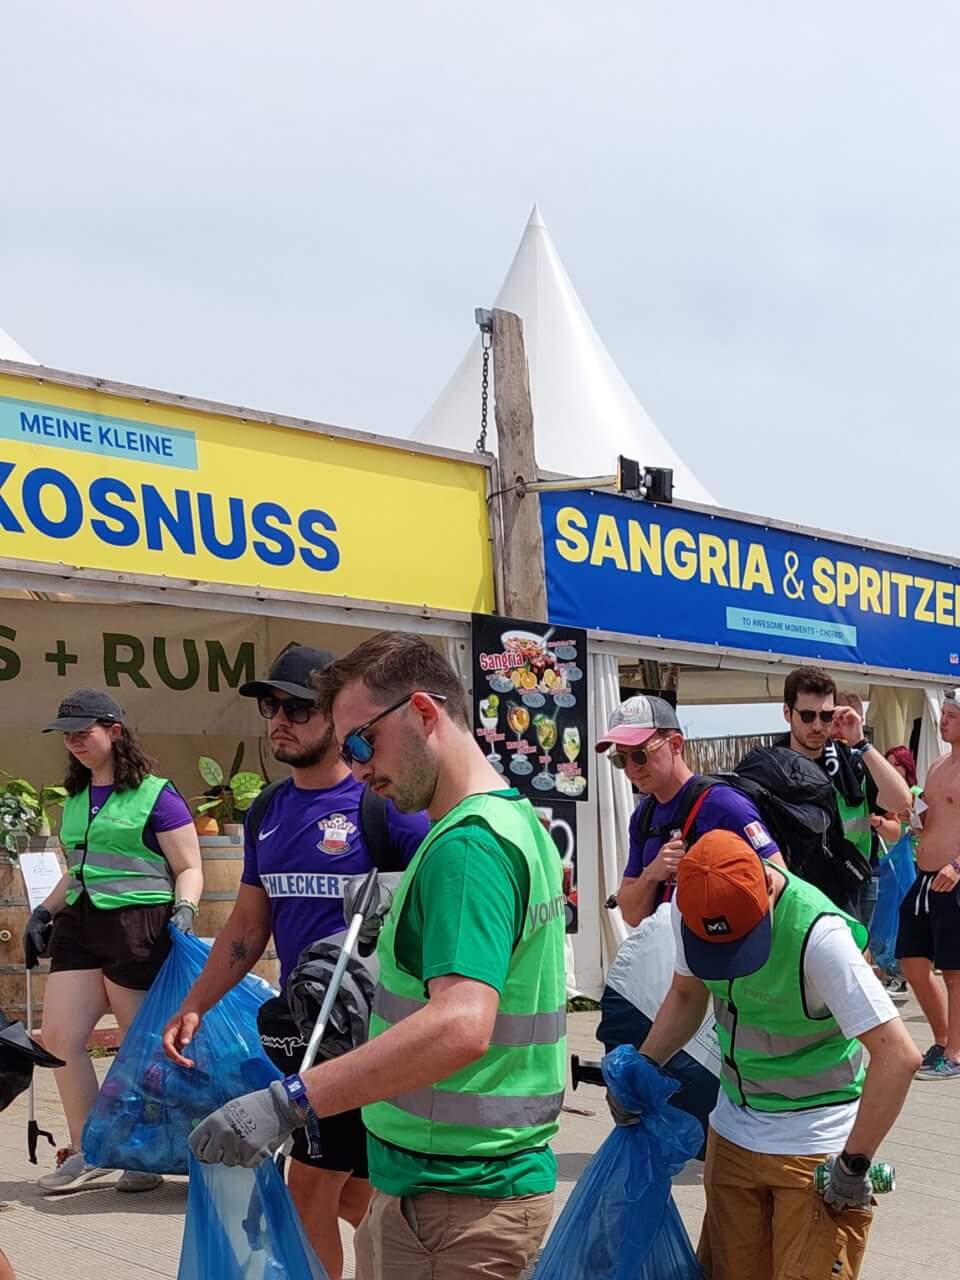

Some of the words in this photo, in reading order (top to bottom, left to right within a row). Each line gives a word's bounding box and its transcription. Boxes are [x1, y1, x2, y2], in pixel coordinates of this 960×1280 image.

[20, 411, 92, 443] MEINE
[99, 426, 173, 457] KLEINE
[555, 506, 775, 595] SANGRIA
[783, 551, 805, 601] &
[742, 616, 752, 626] TO
[752, 619, 783, 631] AWESOME
[785, 623, 815, 636] MOMENTS
[103, 632, 256, 692] RUM
[479, 650, 524, 673] Sangria
